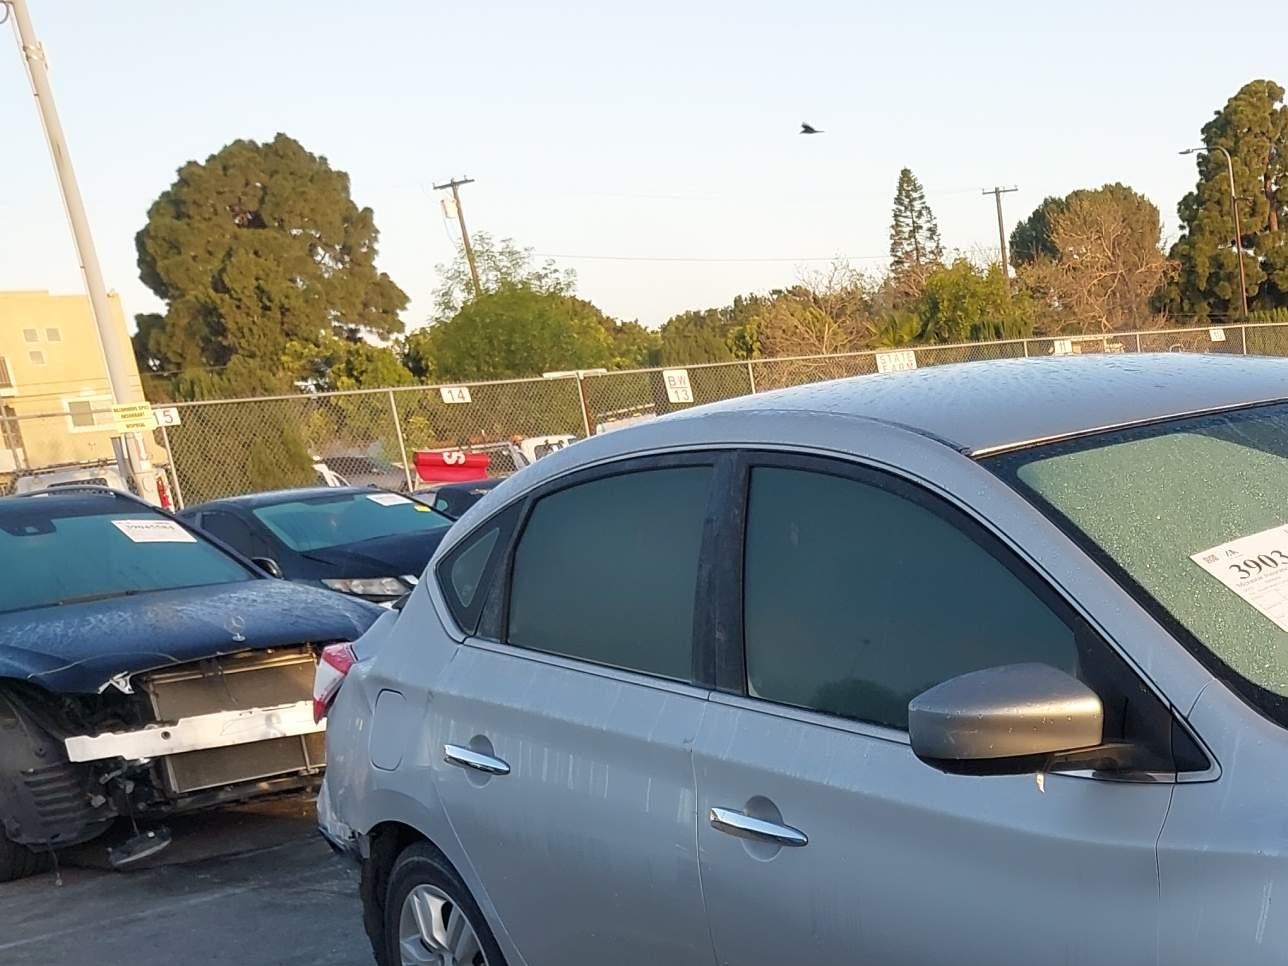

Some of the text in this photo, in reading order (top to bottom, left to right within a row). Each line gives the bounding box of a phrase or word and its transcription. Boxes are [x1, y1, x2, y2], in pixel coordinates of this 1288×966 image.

[879, 352, 914, 365] STATE
[447, 389, 466, 402] 14
[674, 389, 690, 401] 13
[152, 409, 174, 425] 15
